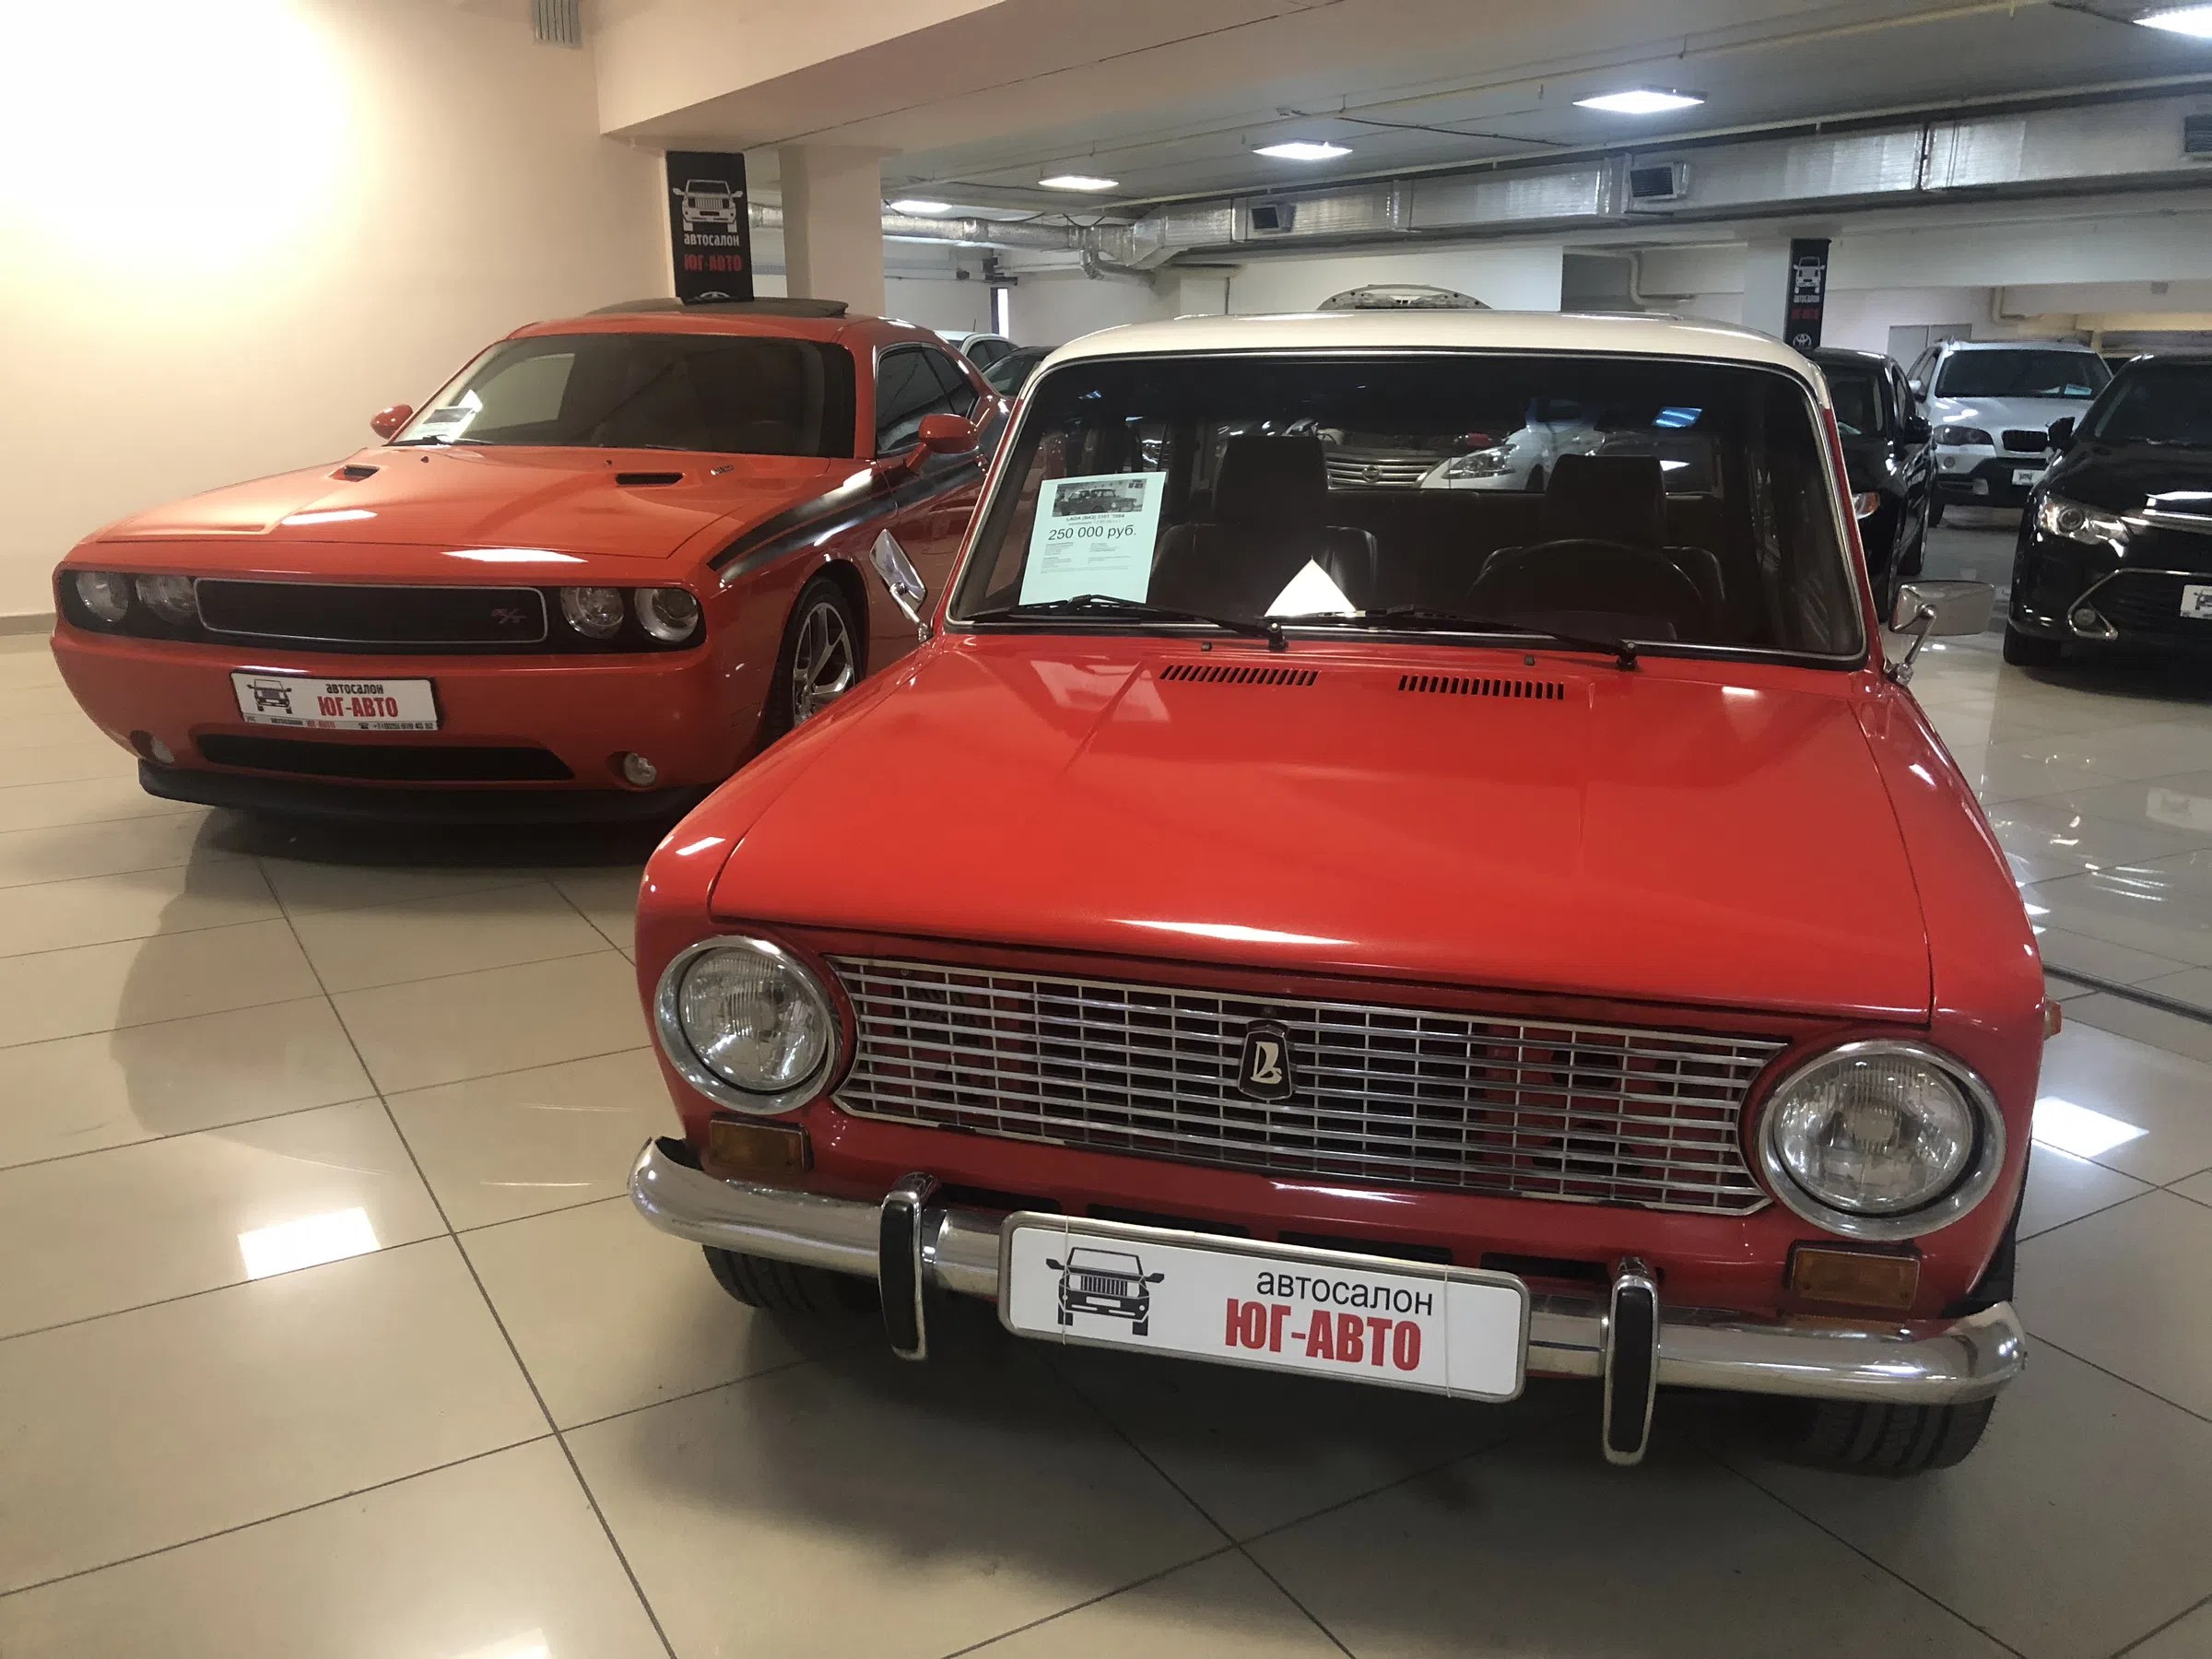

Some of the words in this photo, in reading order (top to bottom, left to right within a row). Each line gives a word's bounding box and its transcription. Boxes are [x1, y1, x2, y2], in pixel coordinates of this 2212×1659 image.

[684, 233, 739, 246] автосалон
[1048, 527, 1074, 541] 250
[1077, 525, 1103, 538] 000
[1107, 524, 1136, 539] руб.
[325, 683, 384, 695] автосалон
[317, 695, 399, 718] ЮГ-АВТО
[1256, 1271, 1433, 1315] автосалон
[1225, 1298, 1421, 1371] ЮГ-АВТО
